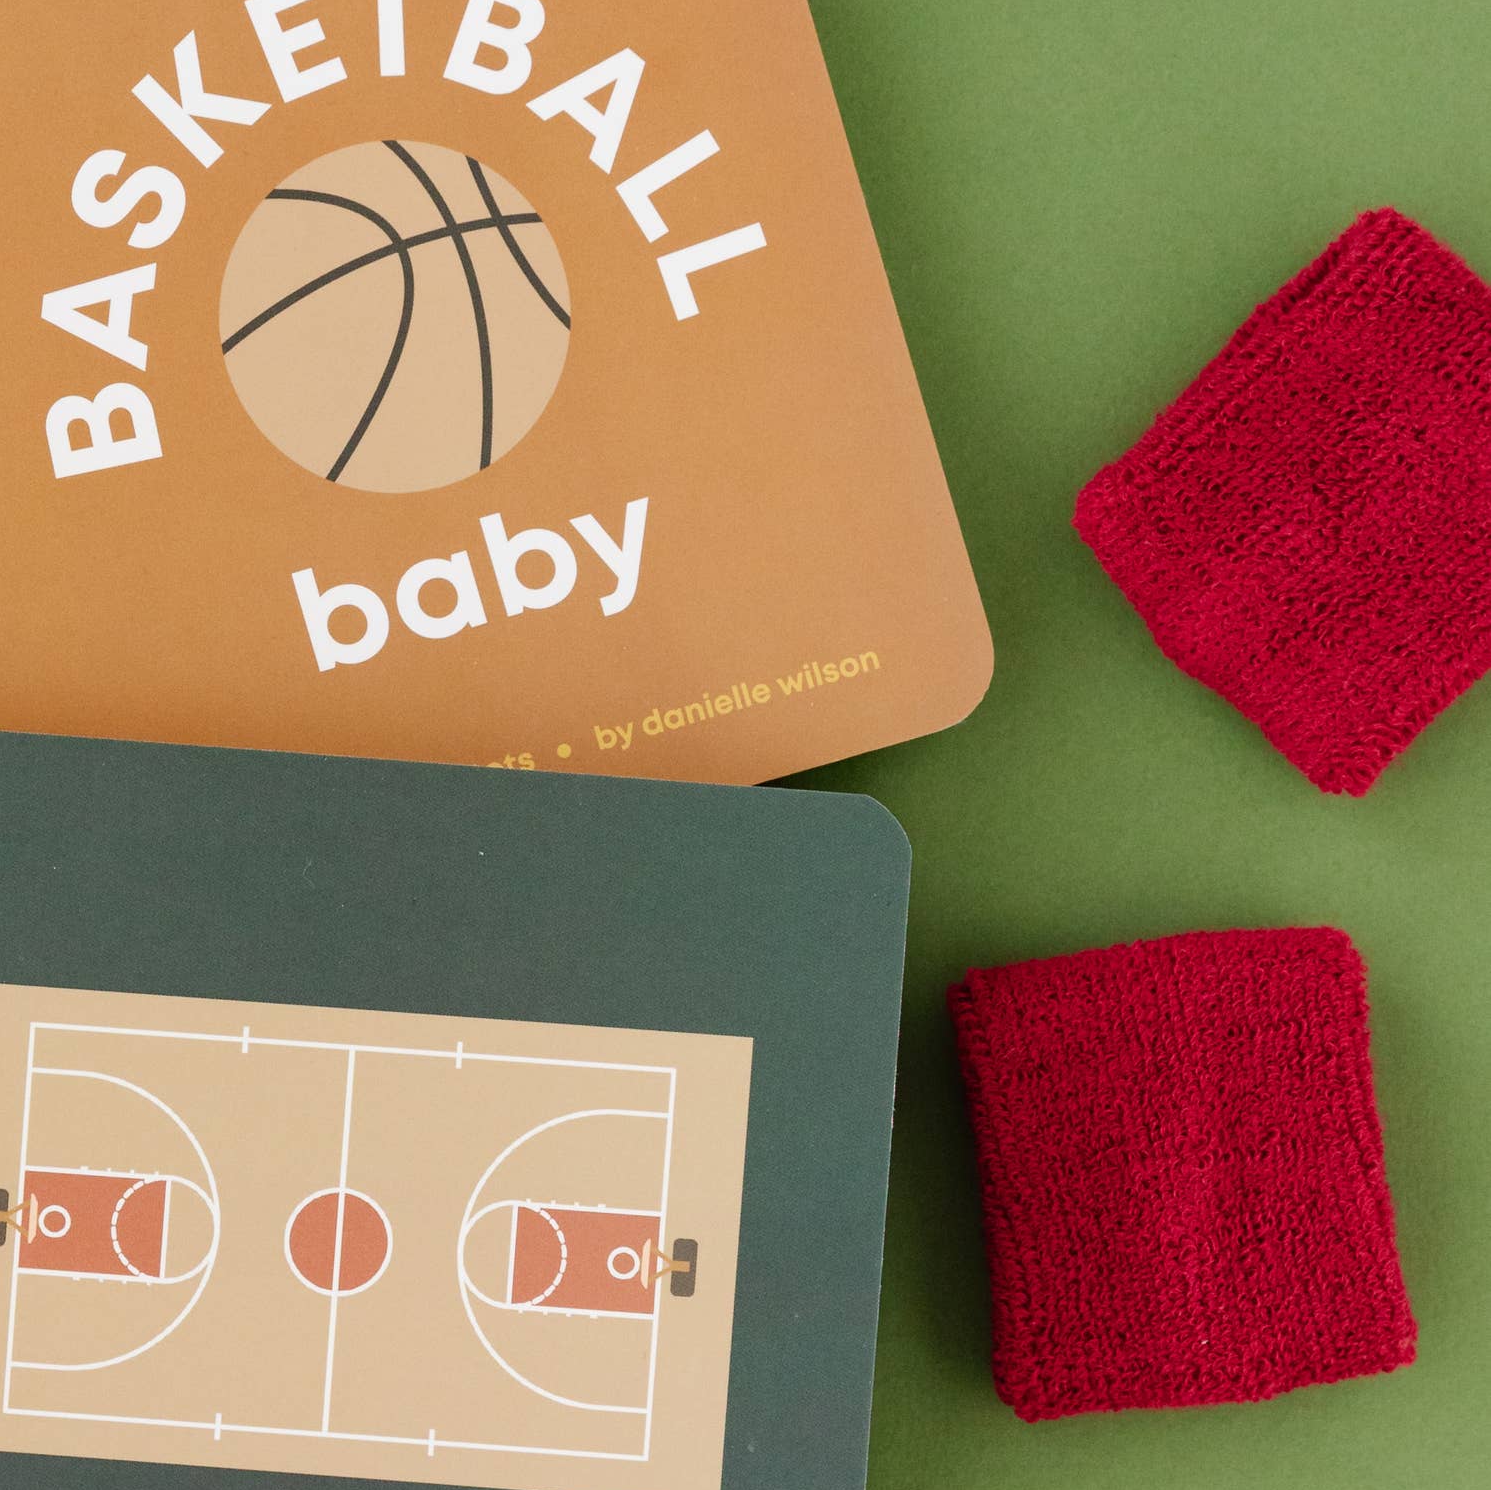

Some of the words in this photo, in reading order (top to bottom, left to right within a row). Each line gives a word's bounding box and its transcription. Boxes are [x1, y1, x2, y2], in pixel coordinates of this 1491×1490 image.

[292, 497, 649, 672] baby
[593, 721, 634, 751] by
[641, 681, 772, 736] danielle
[776, 651, 881, 696] wilson
